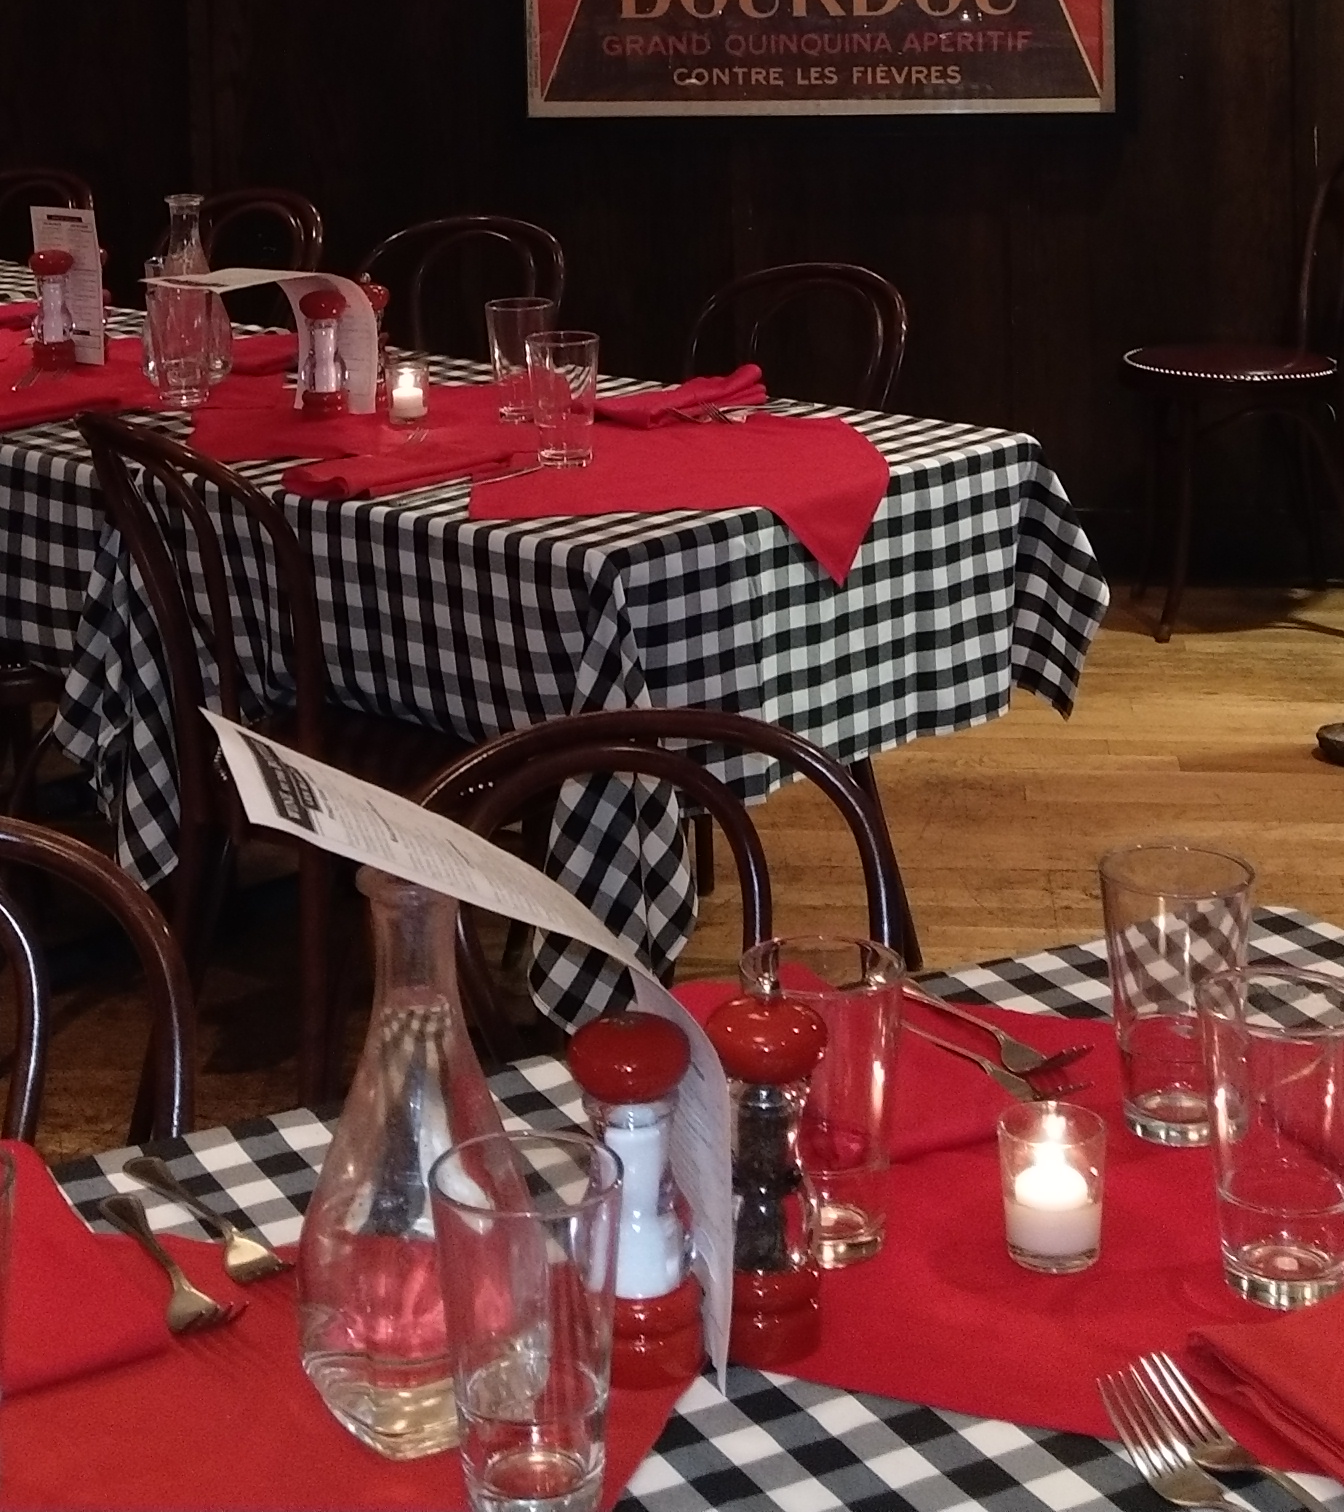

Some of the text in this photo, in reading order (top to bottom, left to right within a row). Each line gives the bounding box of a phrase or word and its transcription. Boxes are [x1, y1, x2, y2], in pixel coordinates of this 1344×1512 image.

[602, 33, 710, 57] GRAND
[724, 31, 891, 58] QUINQUINA
[673, 62, 962, 86] CONTRE LES FIÈVRES
